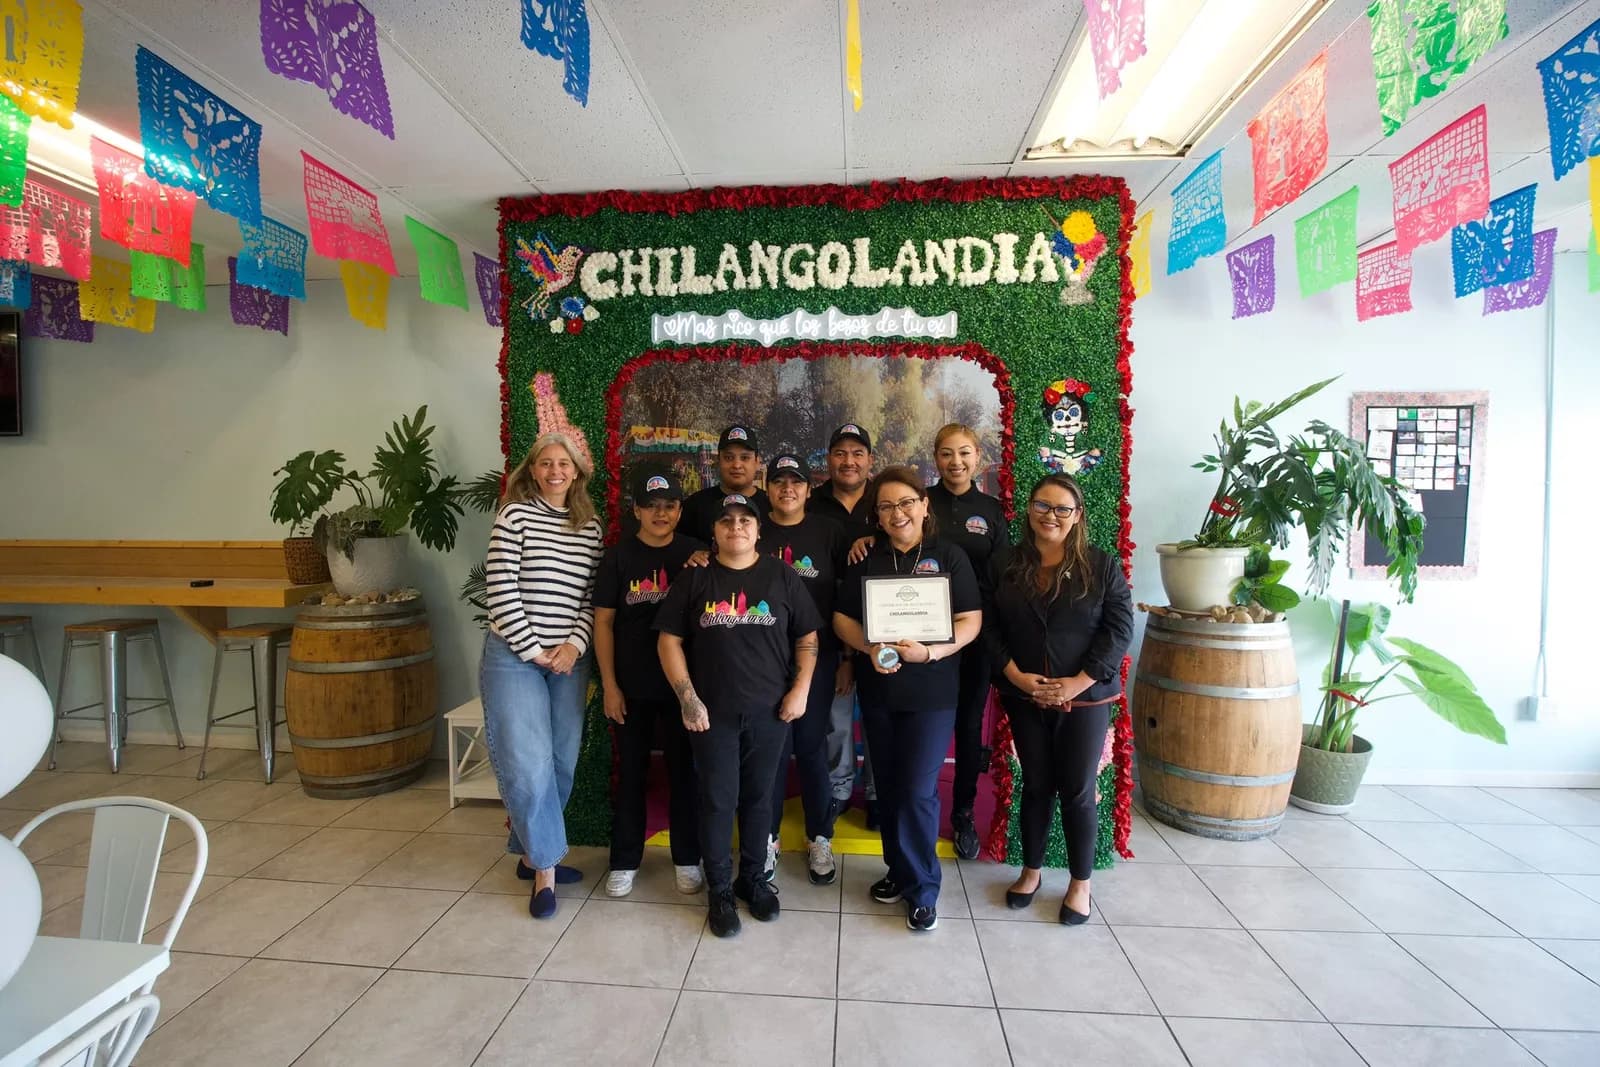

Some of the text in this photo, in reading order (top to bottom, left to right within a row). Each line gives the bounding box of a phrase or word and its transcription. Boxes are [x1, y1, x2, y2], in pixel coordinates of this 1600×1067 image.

[580, 231, 1060, 300] CHILANGOLANDIA
[677, 314, 718, 342] Mas
[722, 311, 755, 337] rico
[795, 310, 821, 337] los
[828, 309, 871, 337] besos
[876, 309, 898, 334] de
[900, 309, 924, 335] tu
[927, 318, 946, 338] ex
